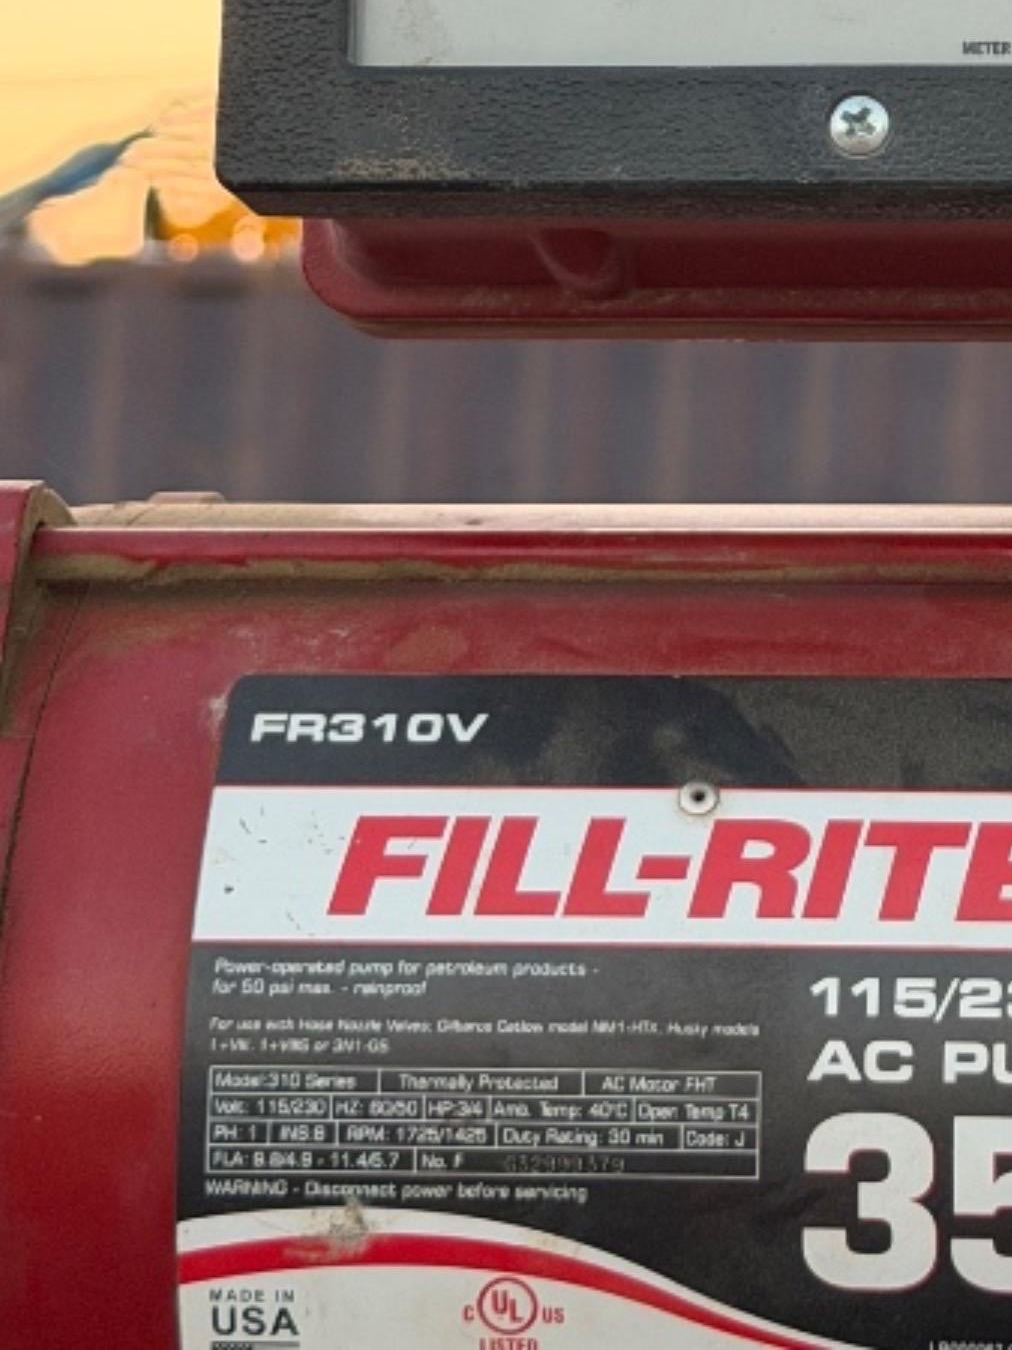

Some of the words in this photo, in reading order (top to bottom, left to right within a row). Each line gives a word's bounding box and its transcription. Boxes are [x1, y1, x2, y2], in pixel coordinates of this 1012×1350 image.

[962, 41, 1011, 56] METER
[250, 712, 489, 743] FR310V
[214, 958, 346, 976] Power-operated
[348, 961, 393, 978] pump
[398, 960, 424, 975] for
[425, 961, 508, 978] petroleum
[512, 961, 586, 979] products
[212, 979, 237, 995] for
[269, 979, 294, 997] psi
[353, 980, 427, 999] rainproof
[209, 1017, 233, 1031] For
[236, 1019, 261, 1032] use
[266, 1017, 294, 1032] with
[806, 1040, 914, 1083] AC
[305, 1073, 357, 1090] Series
[400, 1073, 474, 1093] Thermally
[479, 1074, 559, 1092] Protected
[602, 1076, 625, 1092] AC
[629, 1076, 680, 1093] Motor
[257, 1098, 326, 1115] 115/230
[539, 1101, 583, 1120] Temp:
[685, 1104, 725, 1122] Temp
[729, 1104, 749, 1121] T4
[346, 1126, 391, 1142] RPM:
[503, 1127, 540, 1147] Duty
[546, 1128, 602, 1148] Rating:
[608, 1128, 631, 1145] 30
[635, 1130, 664, 1146] min
[686, 1130, 730, 1147] Code:
[206, 1179, 289, 1197] WARNING
[305, 1180, 397, 1199] Disconnect
[402, 1184, 453, 1201] power
[457, 1182, 508, 1199] before
[514, 1184, 590, 1204] servicing
[209, 1288, 265, 1304] MADE
[275, 1288, 295, 1303] IN
[210, 1305, 300, 1337] USA
[542, 1306, 565, 1324] US
